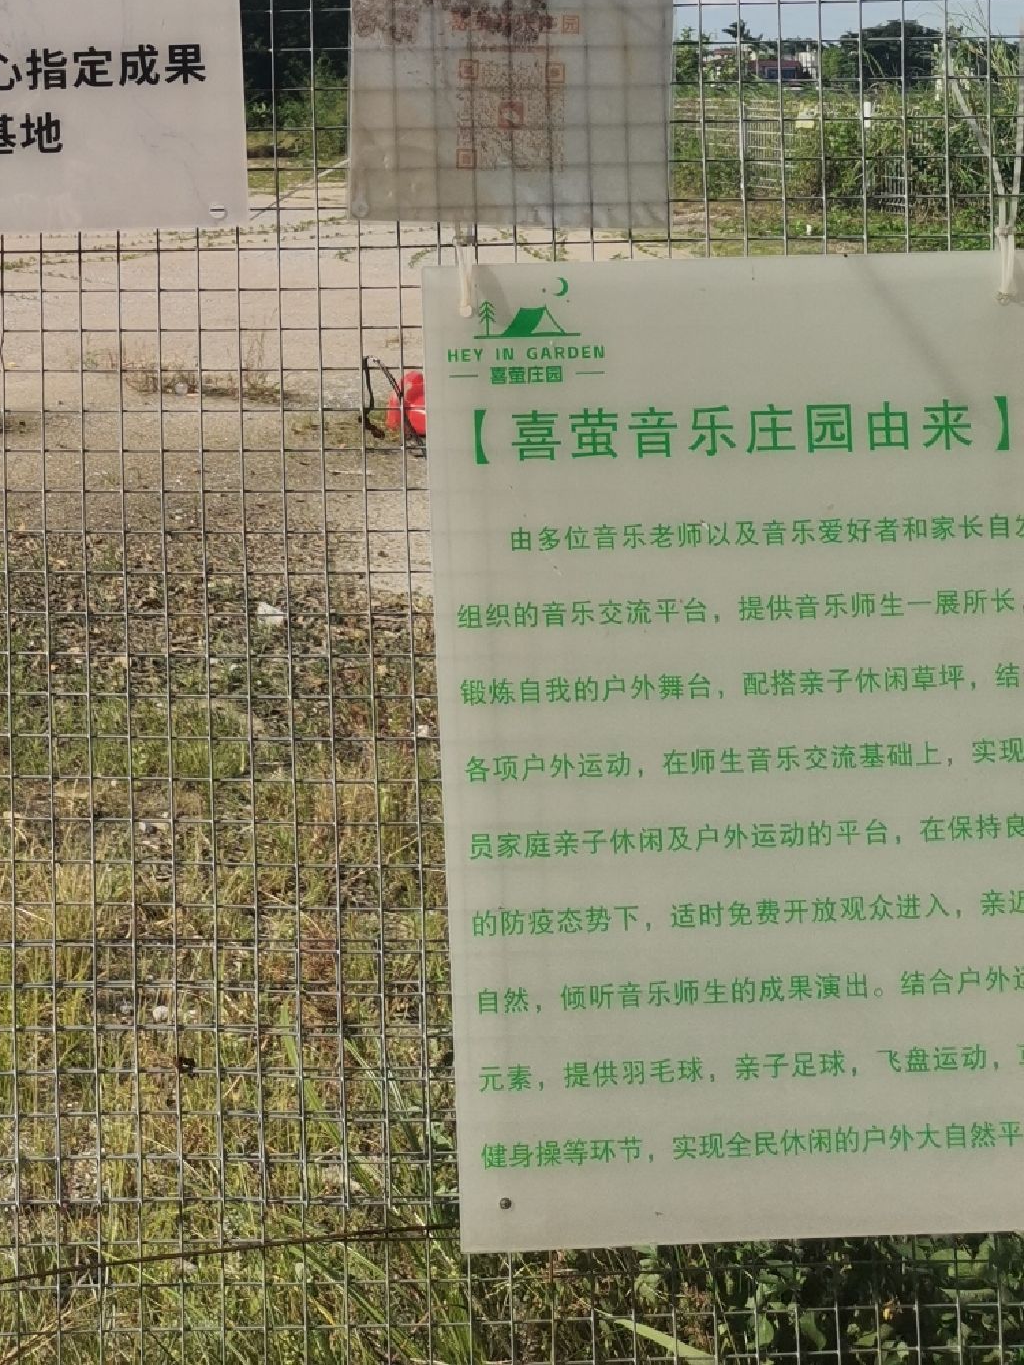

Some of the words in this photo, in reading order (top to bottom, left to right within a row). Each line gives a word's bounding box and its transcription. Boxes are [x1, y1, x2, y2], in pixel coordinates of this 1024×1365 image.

[447, 347, 484, 363] HEY
[495, 346, 514, 361] IN
[526, 344, 606, 361] GARDEN
[489, 364, 564, 386] 喜萤庄园
[472, 395, 1011, 466] 【喜萤音乐庄园由来】
[456, 586, 1024, 629] 组织的音乐交流平台，提供音乐师生一展所长
